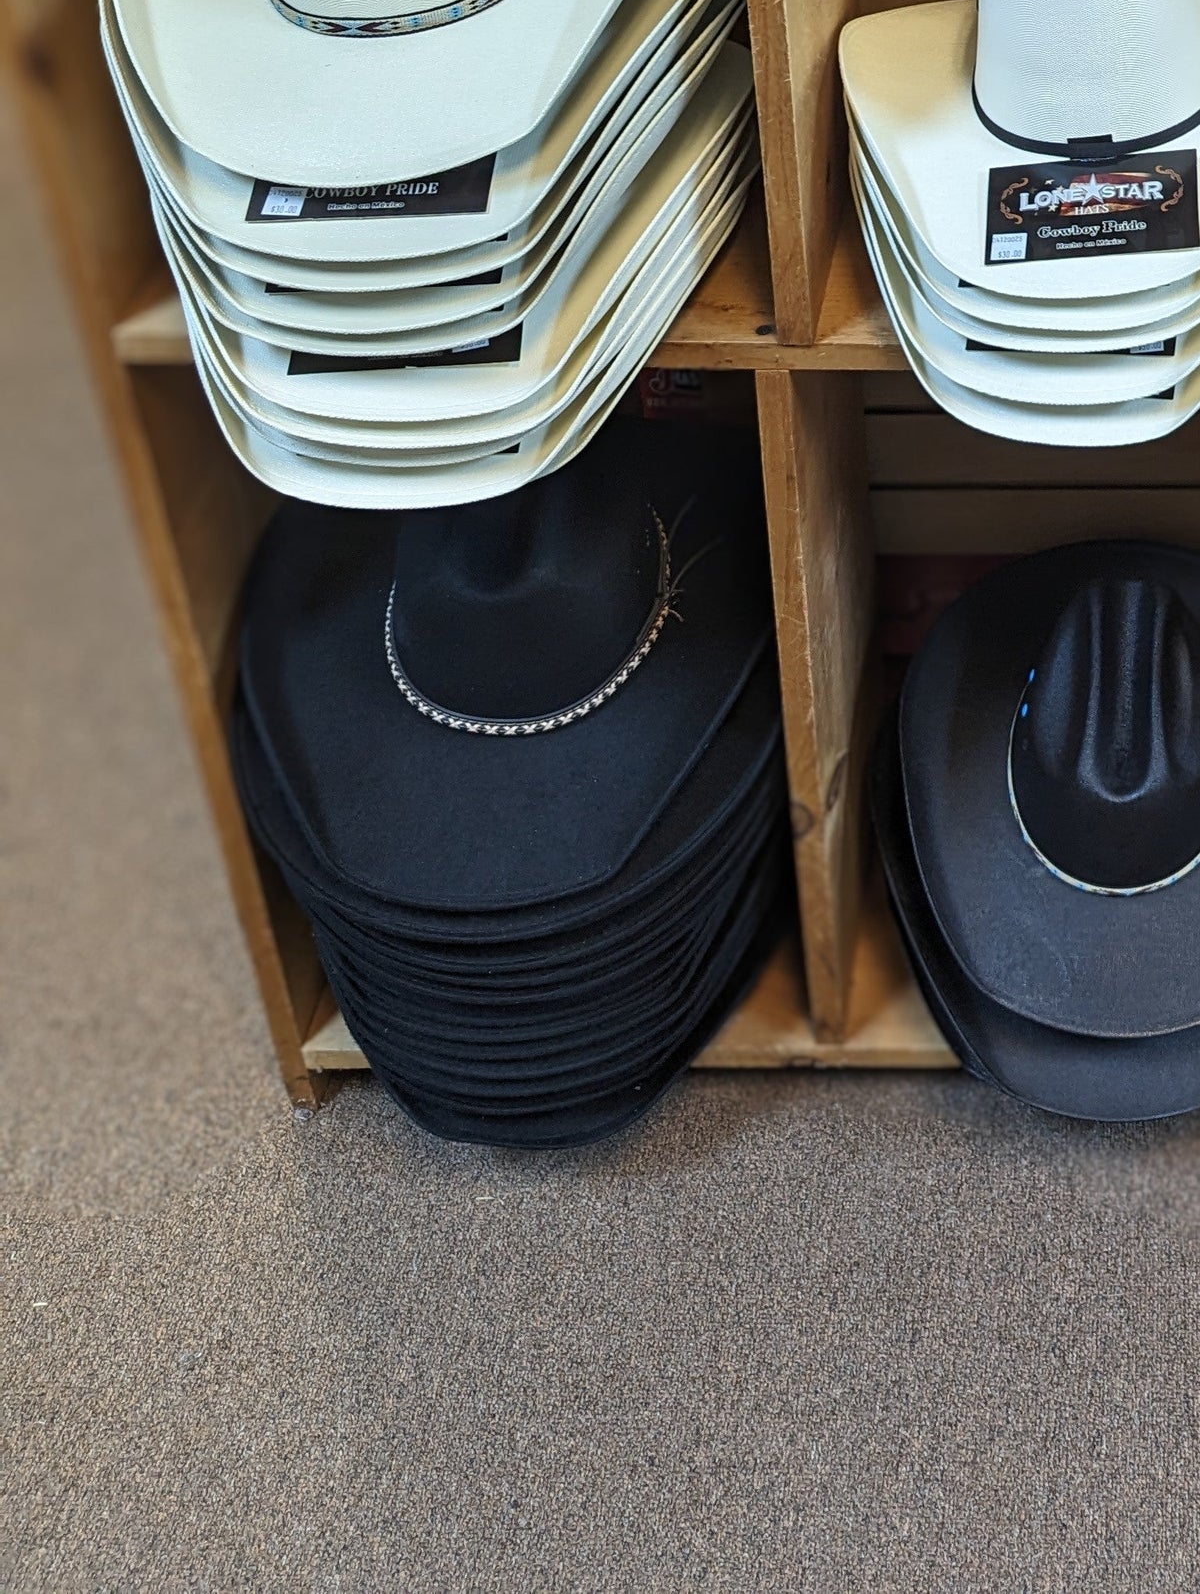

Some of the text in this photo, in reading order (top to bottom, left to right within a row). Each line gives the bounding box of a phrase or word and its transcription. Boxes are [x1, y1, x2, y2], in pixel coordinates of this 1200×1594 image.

[386, 182, 439, 196] PRIDE
[1018, 180, 1164, 213] LONE STAR
[326, 202, 357, 210] Hecho
[358, 202, 370, 210] en
[1074, 204, 1110, 216] HATS
[1037, 219, 1148, 239] Cowboy Pride
[1056, 242, 1083, 251] Hecho
[1084, 240, 1096, 249] en
[998, 250, 1023, 259] $30.00
